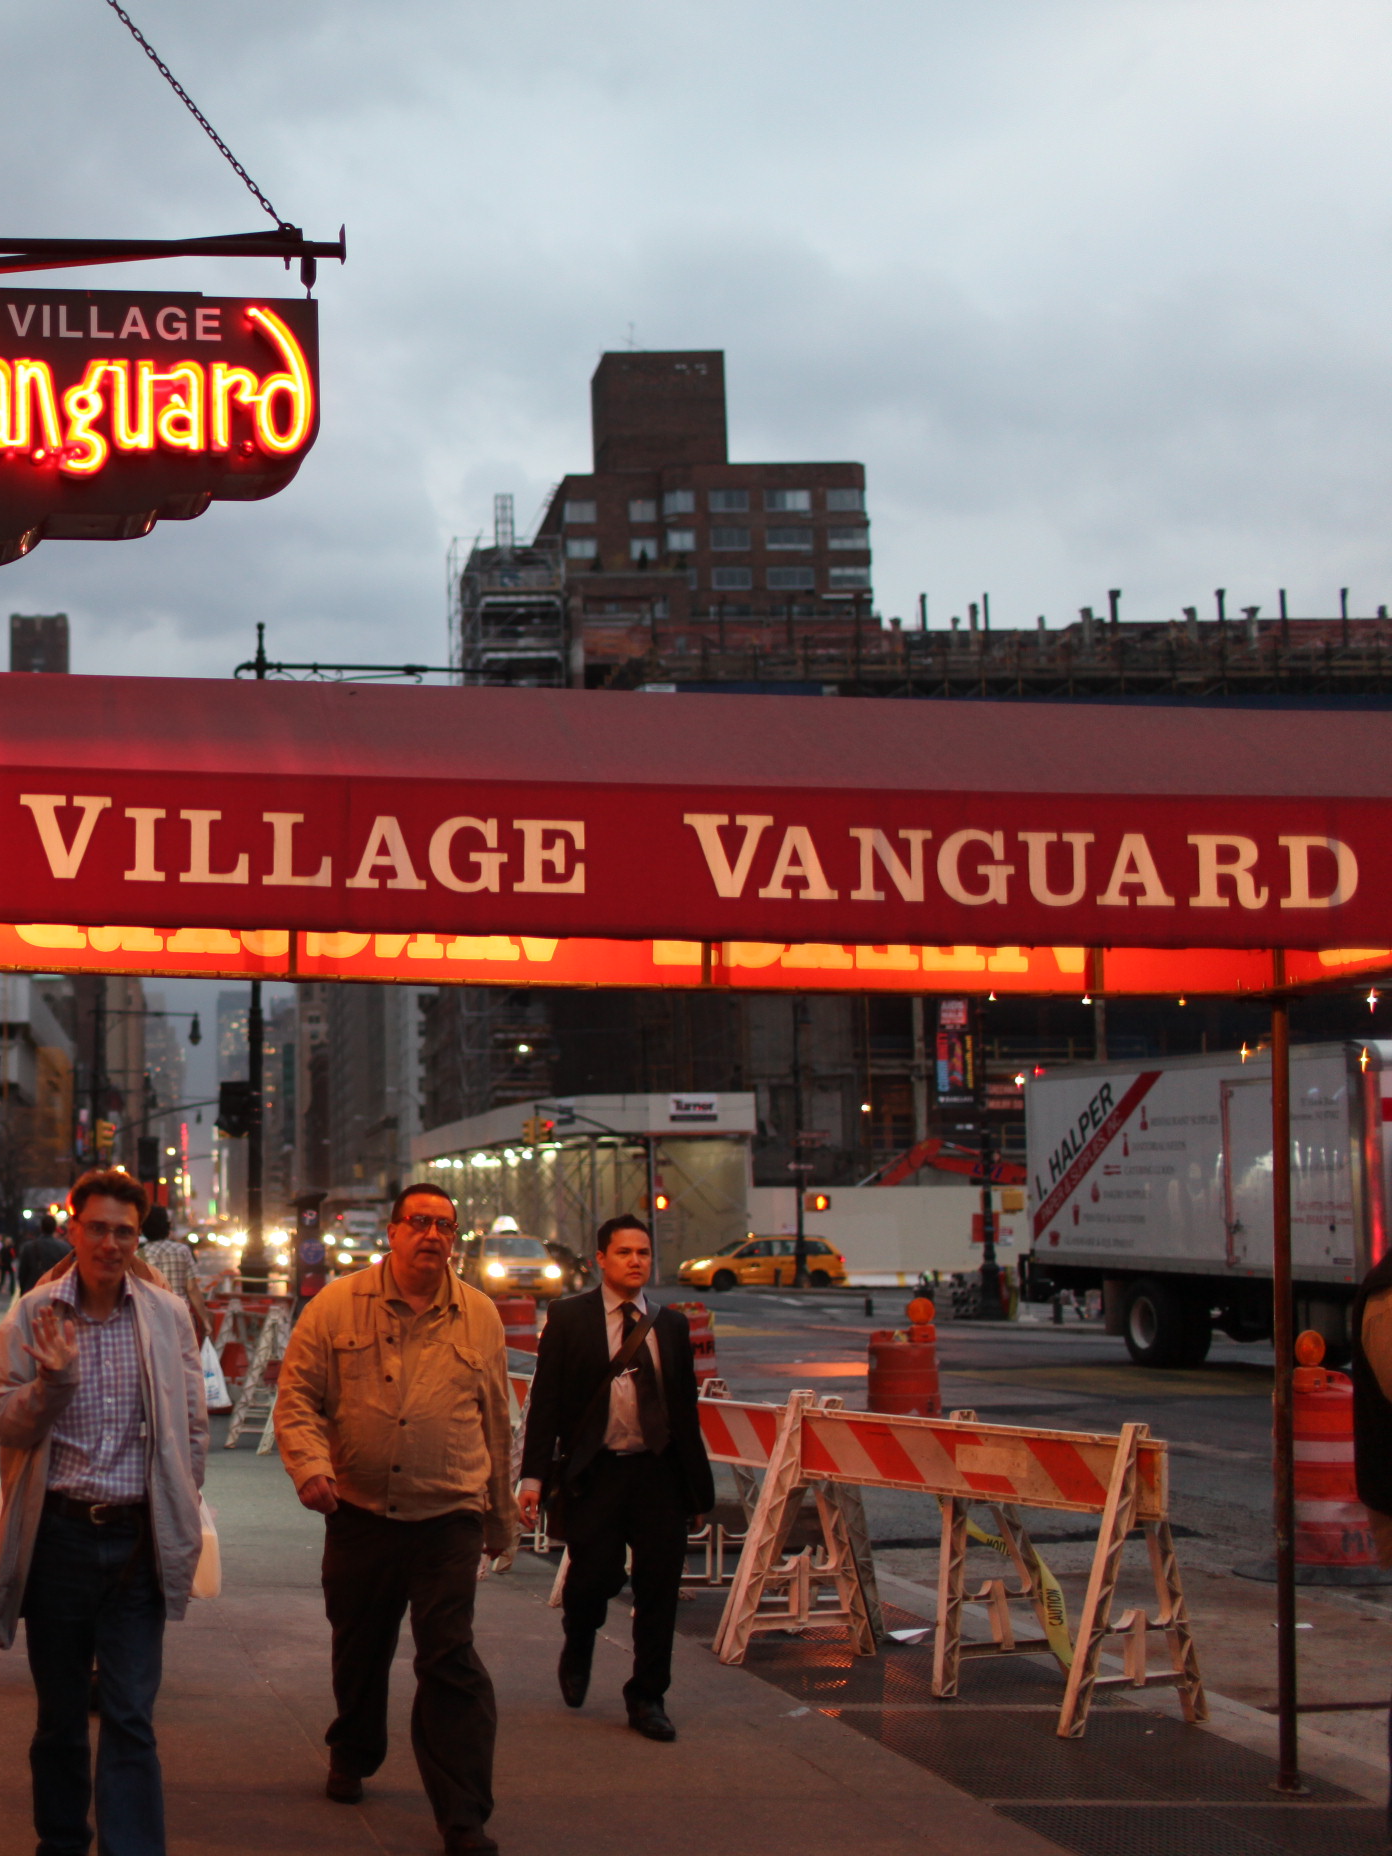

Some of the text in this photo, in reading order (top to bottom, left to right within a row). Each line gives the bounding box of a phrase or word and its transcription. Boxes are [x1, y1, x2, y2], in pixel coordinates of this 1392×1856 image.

[8, 304, 222, 341] VILLAGE
[20, 794, 1359, 909] VILLAGE VANGUARD
[1048, 1082, 1115, 1184] HALPER
[1047, 1588, 1064, 1627] CAUTION
